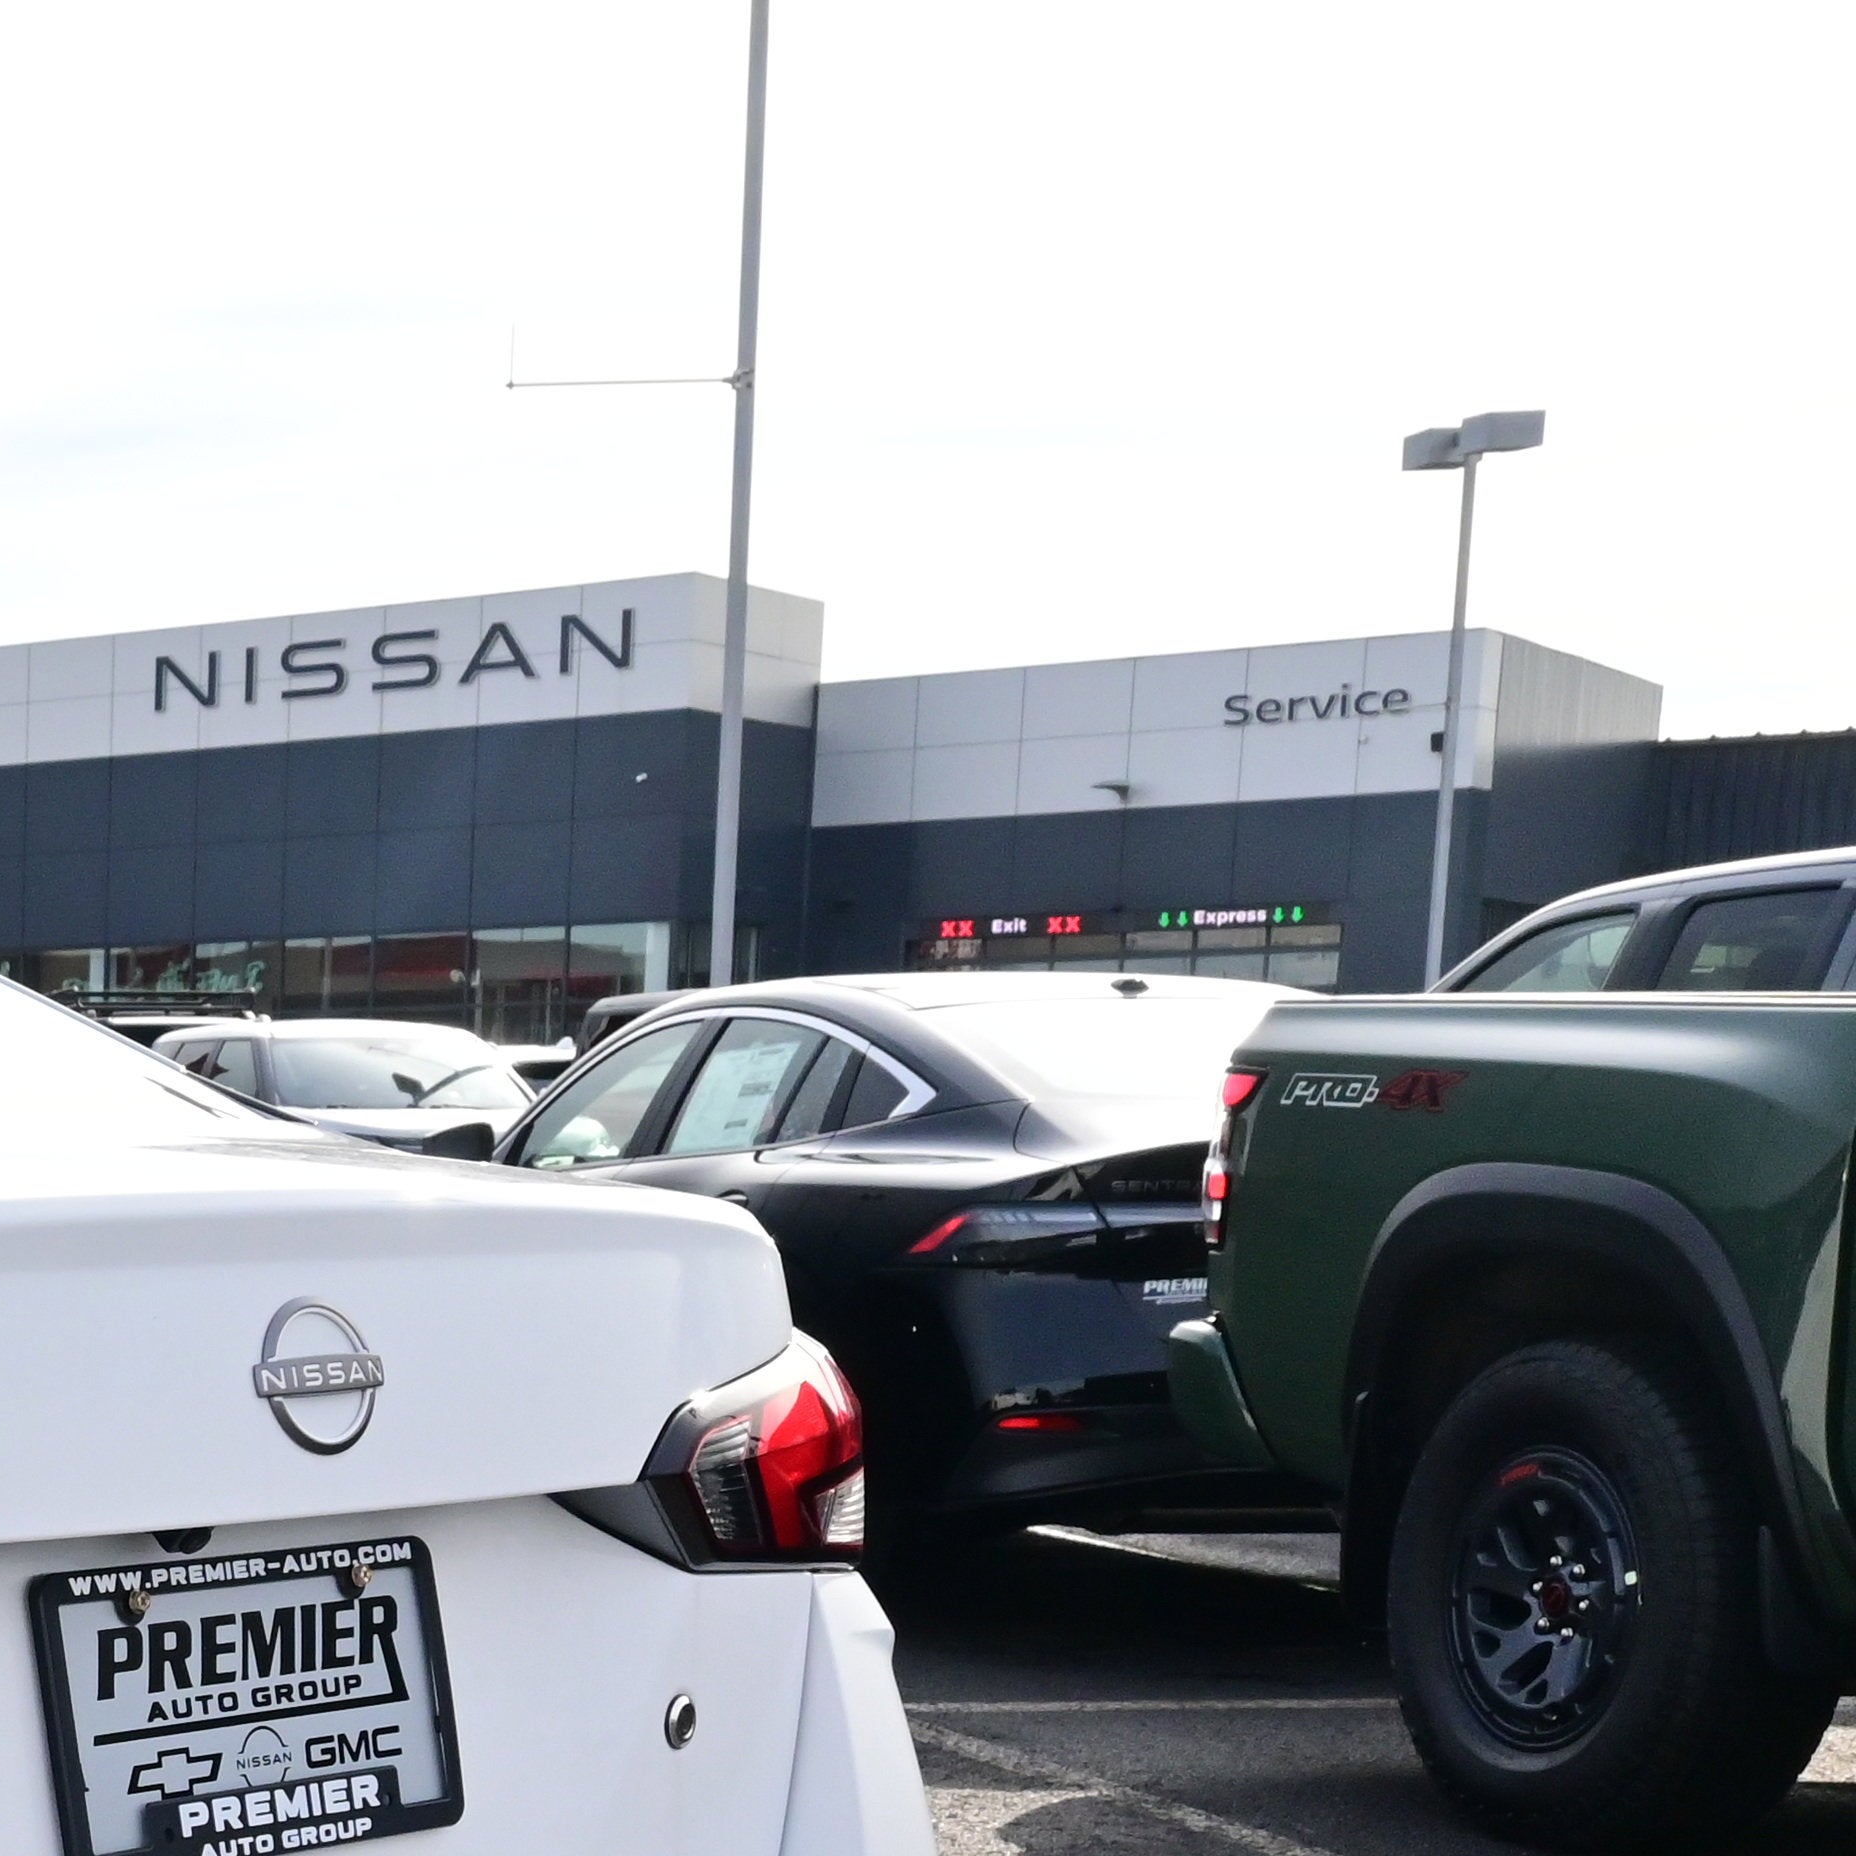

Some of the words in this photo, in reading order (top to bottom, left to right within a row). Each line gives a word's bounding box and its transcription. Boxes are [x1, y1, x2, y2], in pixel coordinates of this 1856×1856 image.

[153, 608, 634, 713] NISSAN
[1224, 682, 1410, 727] Service
[990, 917, 1028, 934] Exit
[1192, 909, 1268, 926] Express
[1143, 1278, 1208, 1296] PREMI
[260, 1359, 383, 1391] NISSAN
[68, 1541, 412, 1597] WWW.PREMIER-AUTO.COM
[96, 1594, 410, 1701] PREMIER
[147, 1693, 239, 1723] AUTO
[250, 1674, 363, 1708] GROUP
[236, 1751, 293, 1770] NISSAN
[305, 1725, 403, 1769] GMC
[178, 1773, 381, 1838] PREMIER
[281, 1817, 373, 1849] GROUP
